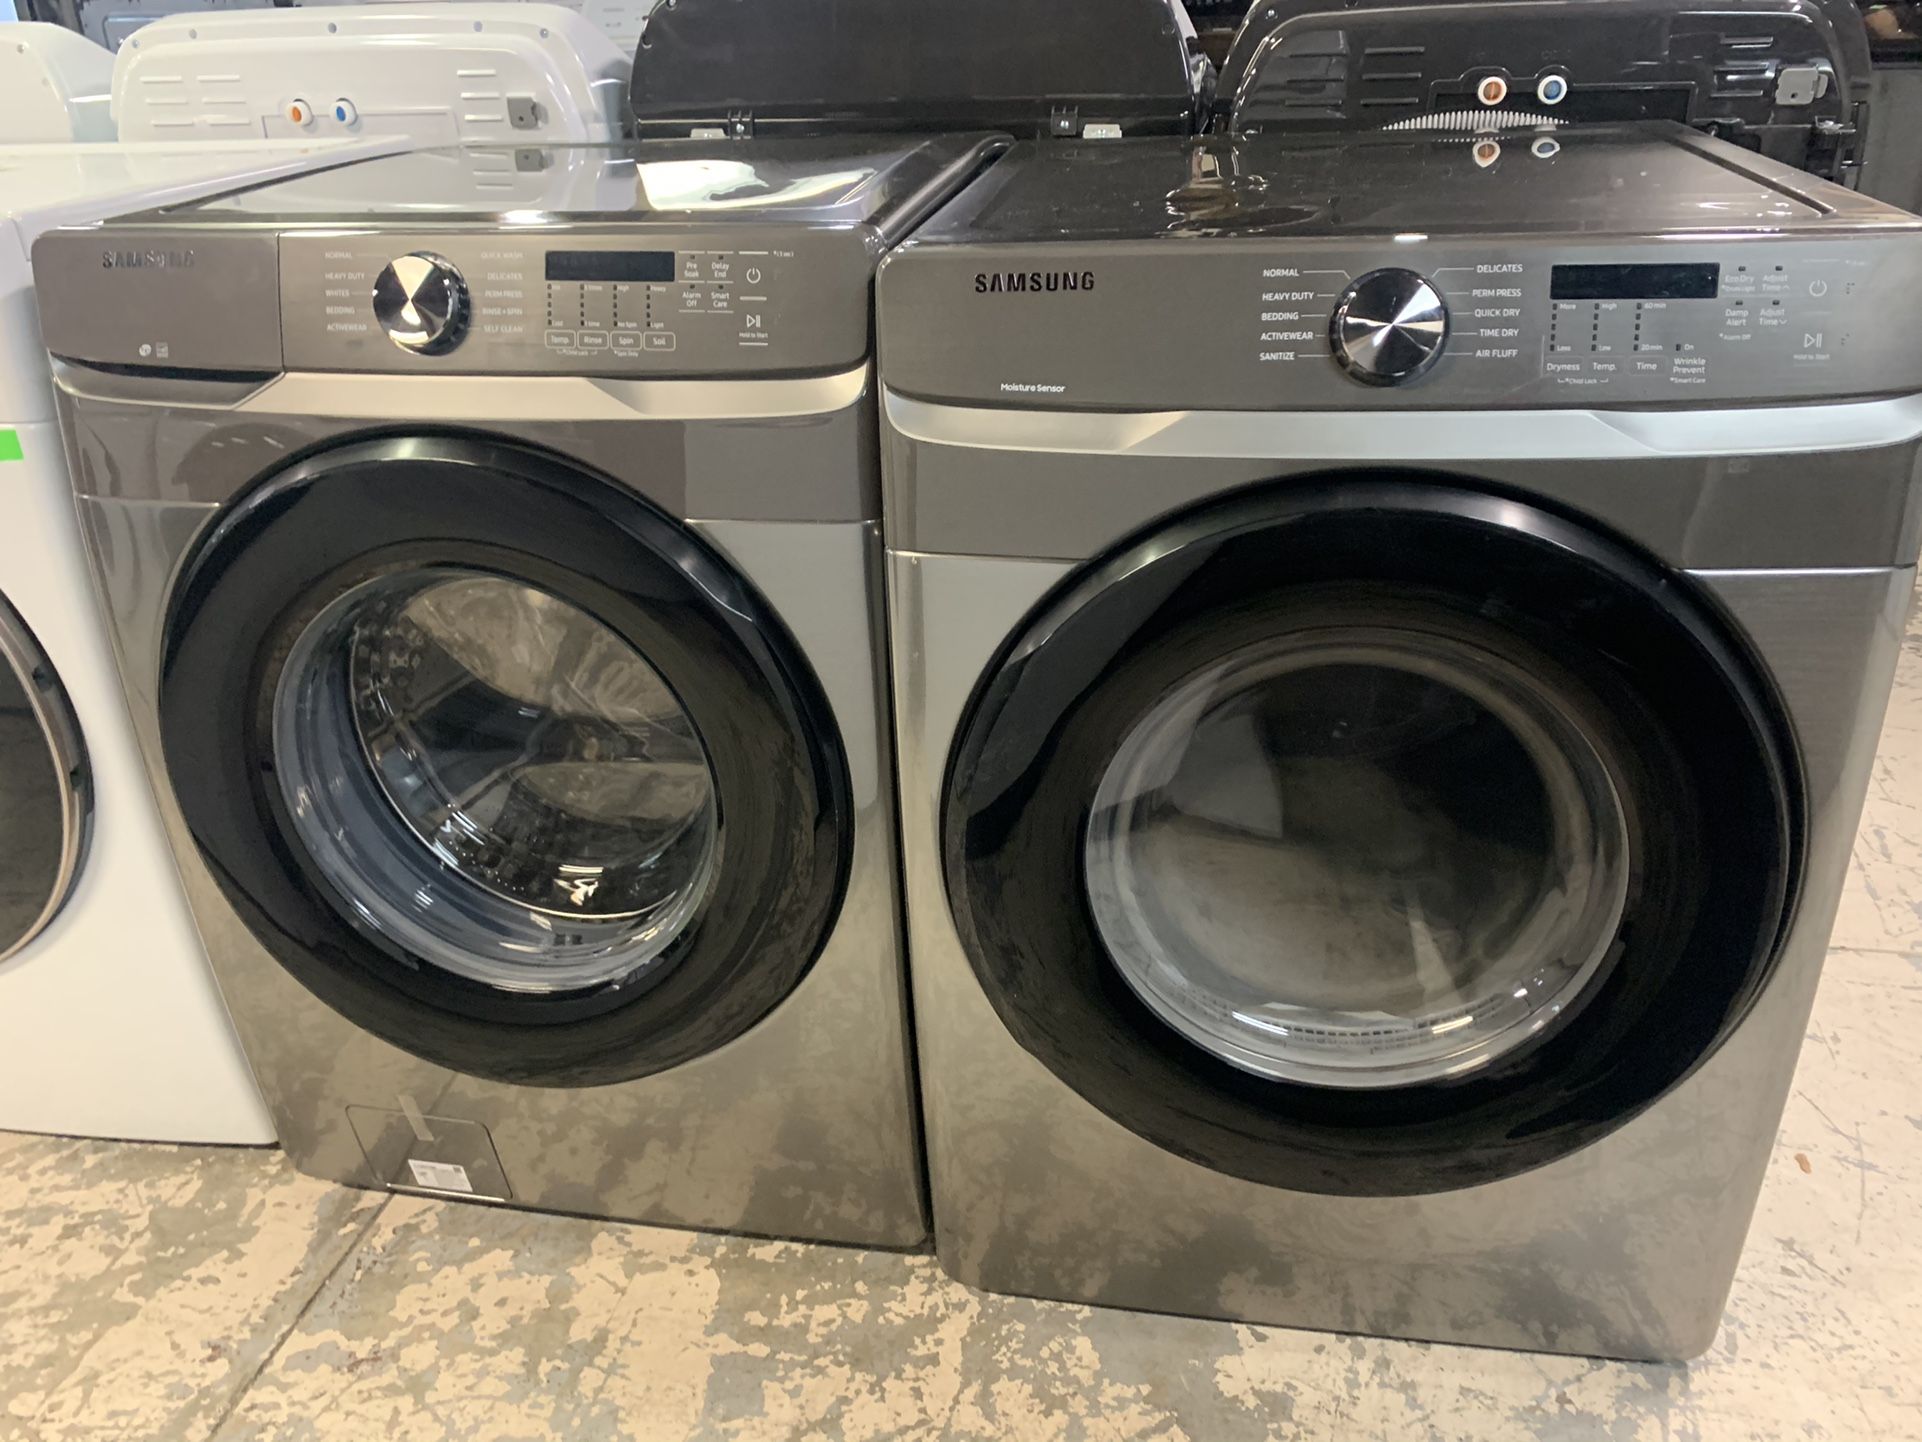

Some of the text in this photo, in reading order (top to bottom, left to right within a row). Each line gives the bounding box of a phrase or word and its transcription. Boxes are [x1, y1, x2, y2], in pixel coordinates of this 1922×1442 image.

[102, 250, 195, 269] SAMSUNG
[711, 262, 729, 270] Delay
[1476, 264, 1523, 273] DELICATES
[325, 272, 365, 280] HEAVY DUTY
[487, 272, 523, 280] DELICATES
[684, 270, 699, 278] Soak
[714, 270, 727, 278] End
[1263, 268, 1300, 277] NORMAL
[974, 271, 1095, 293] SAMSUNG
[1725, 274, 1754, 284] Eco Dry
[1762, 274, 1788, 283] Adjust
[325, 289, 350, 297] WHITES
[485, 290, 523, 298] PERM PRESS
[1262, 292, 1314, 301] HEAVY DUTY
[1472, 288, 1522, 297] PERM PRESS
[713, 300, 727, 308] Care
[1602, 302, 1617, 310] High
[1261, 312, 1299, 321] BEDDING
[1474, 308, 1520, 318] QUICK DRY
[1725, 309, 1749, 318] Damp
[1760, 308, 1785, 317] Adjust
[1726, 318, 1747, 326] Alert
[1759, 318, 1779, 326] Time
[327, 324, 367, 332] ACTIVEWEAR
[484, 325, 523, 333] SELF CLEAN
[1260, 332, 1314, 341] ACTIVEWEAR
[1480, 328, 1519, 337] TIME DRY
[584, 336, 602, 344] Rinse
[619, 337, 634, 345] Spin
[653, 337, 666, 345] Soil
[1684, 343, 1694, 351] On
[1259, 352, 1295, 361] SANITIZE
[1475, 349, 1518, 358] AIR FLUFF
[1674, 357, 1706, 365] Wrinkle
[1546, 362, 1580, 372] Dryness
[1593, 362, 1616, 371] Temp.
[1637, 362, 1657, 370] Time
[1673, 366, 1705, 374] Prevent
[1000, 383, 1066, 393] Moisture Sensor
